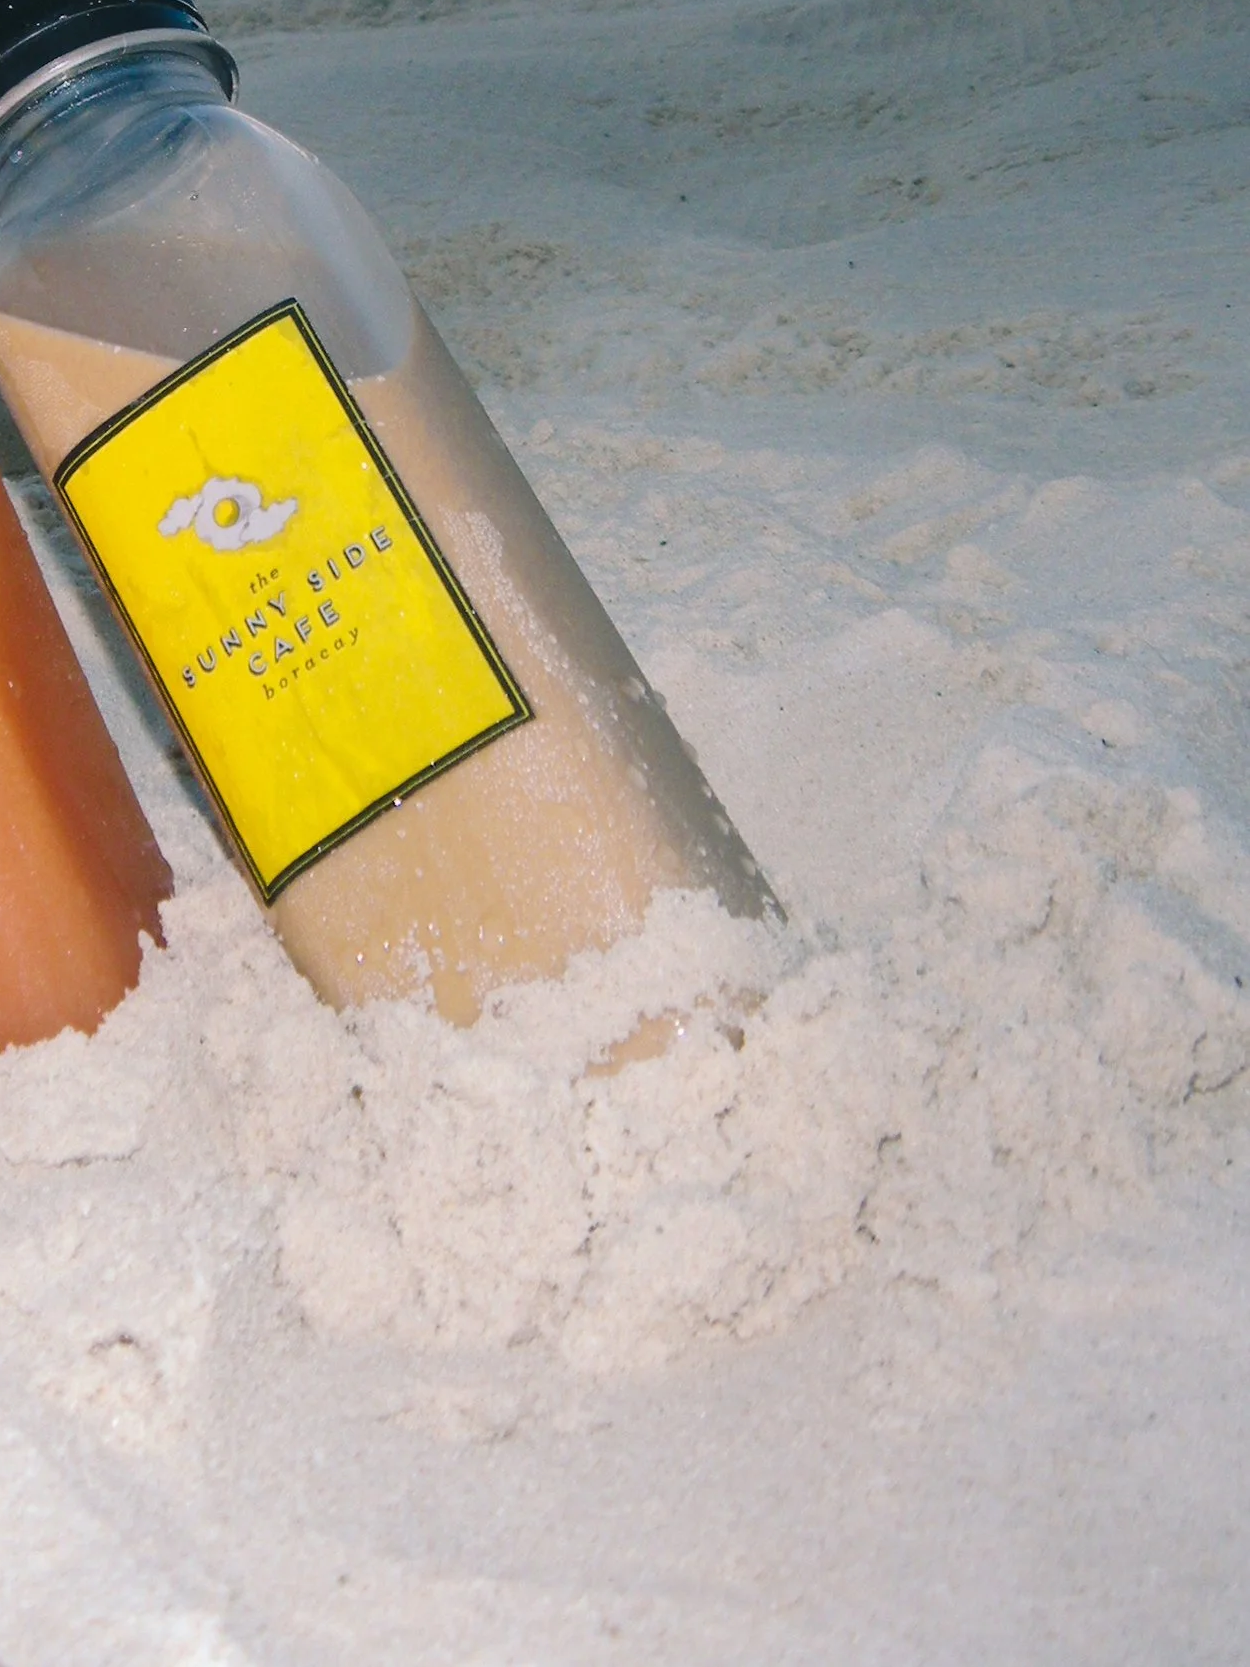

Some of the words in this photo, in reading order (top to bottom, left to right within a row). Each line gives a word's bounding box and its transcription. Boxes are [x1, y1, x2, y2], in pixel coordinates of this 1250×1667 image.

[182, 590, 287, 687] SUNNY
[307, 525, 393, 592] SIDE
[249, 567, 279, 594] the
[248, 599, 340, 676] CAFE
[262, 626, 359, 701] boracay
